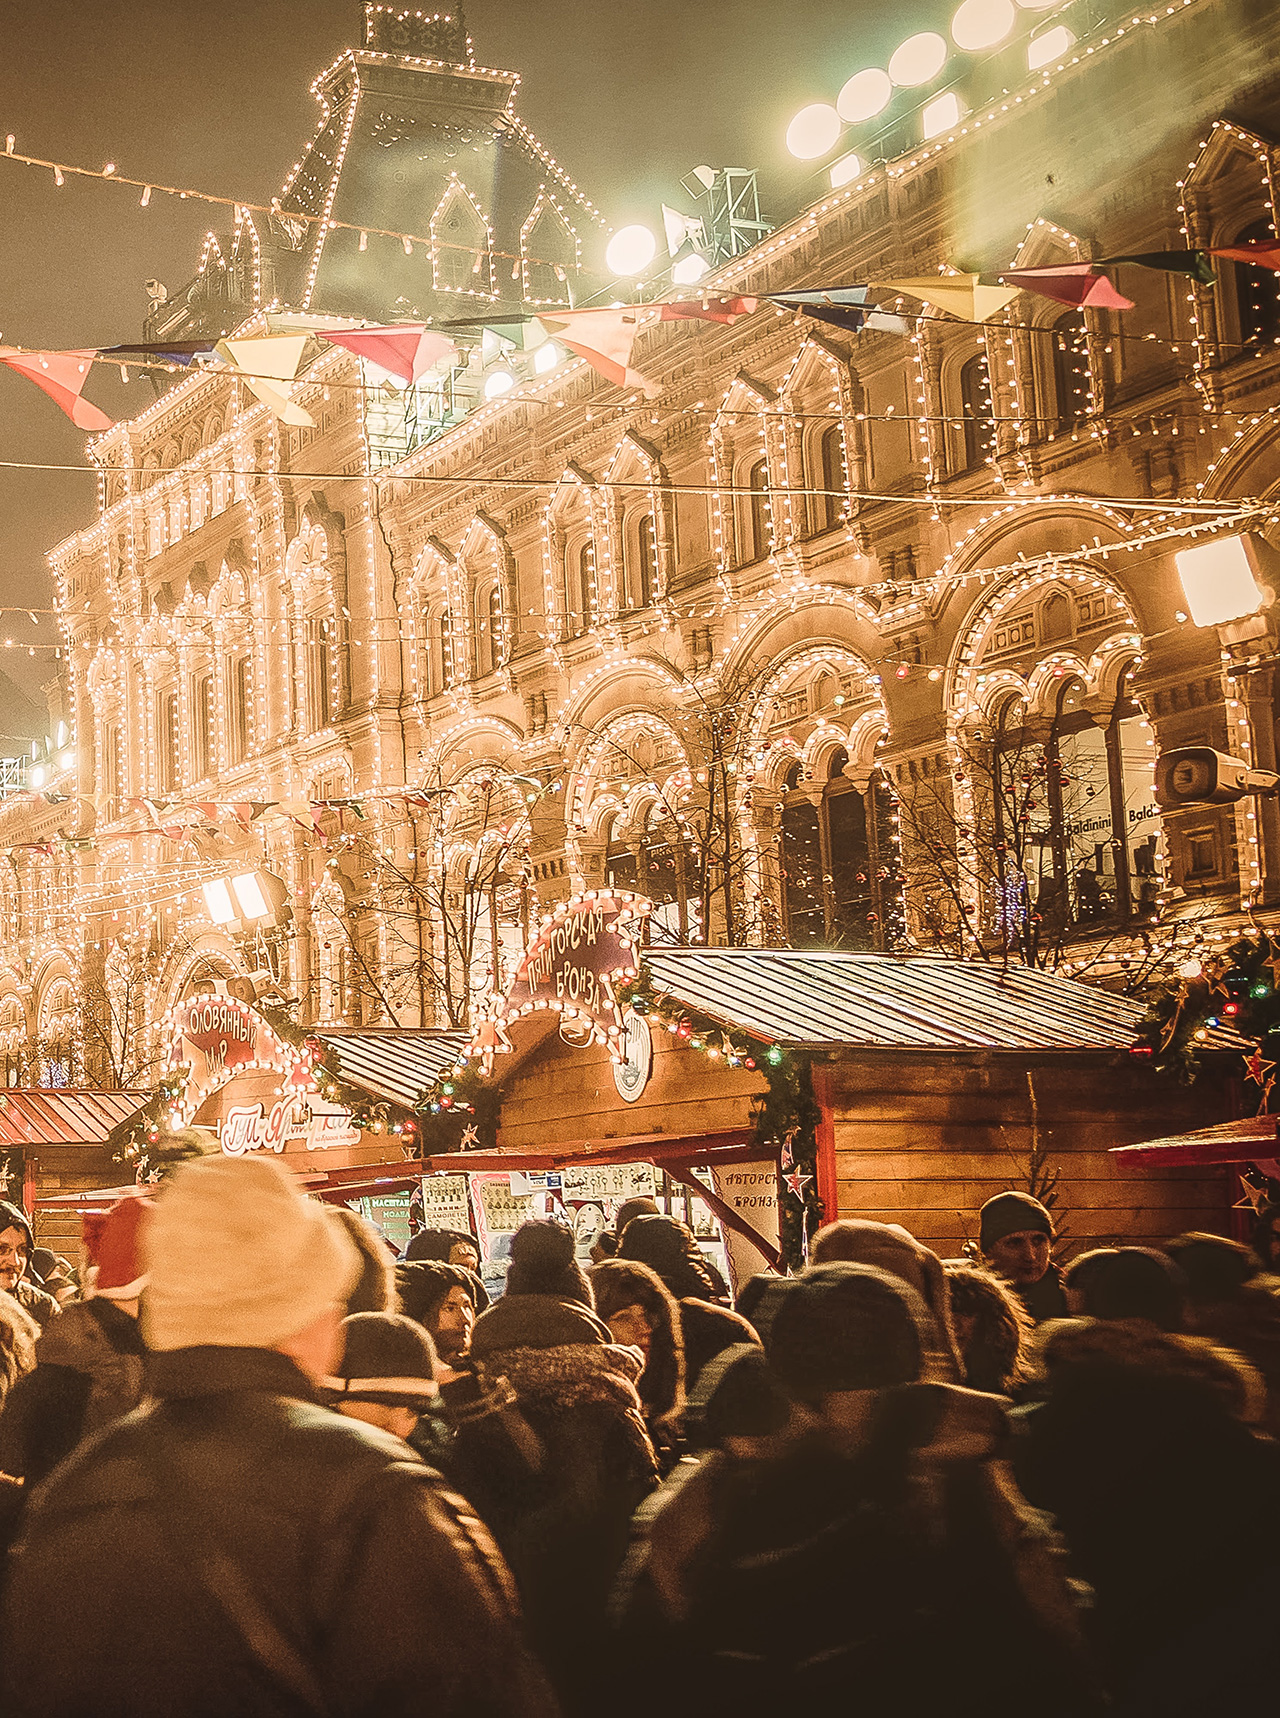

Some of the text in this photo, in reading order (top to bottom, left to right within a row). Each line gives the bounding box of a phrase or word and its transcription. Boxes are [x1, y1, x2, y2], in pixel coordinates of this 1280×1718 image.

[527, 906, 604, 995] ПЯТИГОРСКАЯ
[556, 960, 600, 1015] БРОНЗА
[190, 1004, 258, 1049] ОЛОВЯННЫЙ
[205, 1039, 228, 1078] МИР
